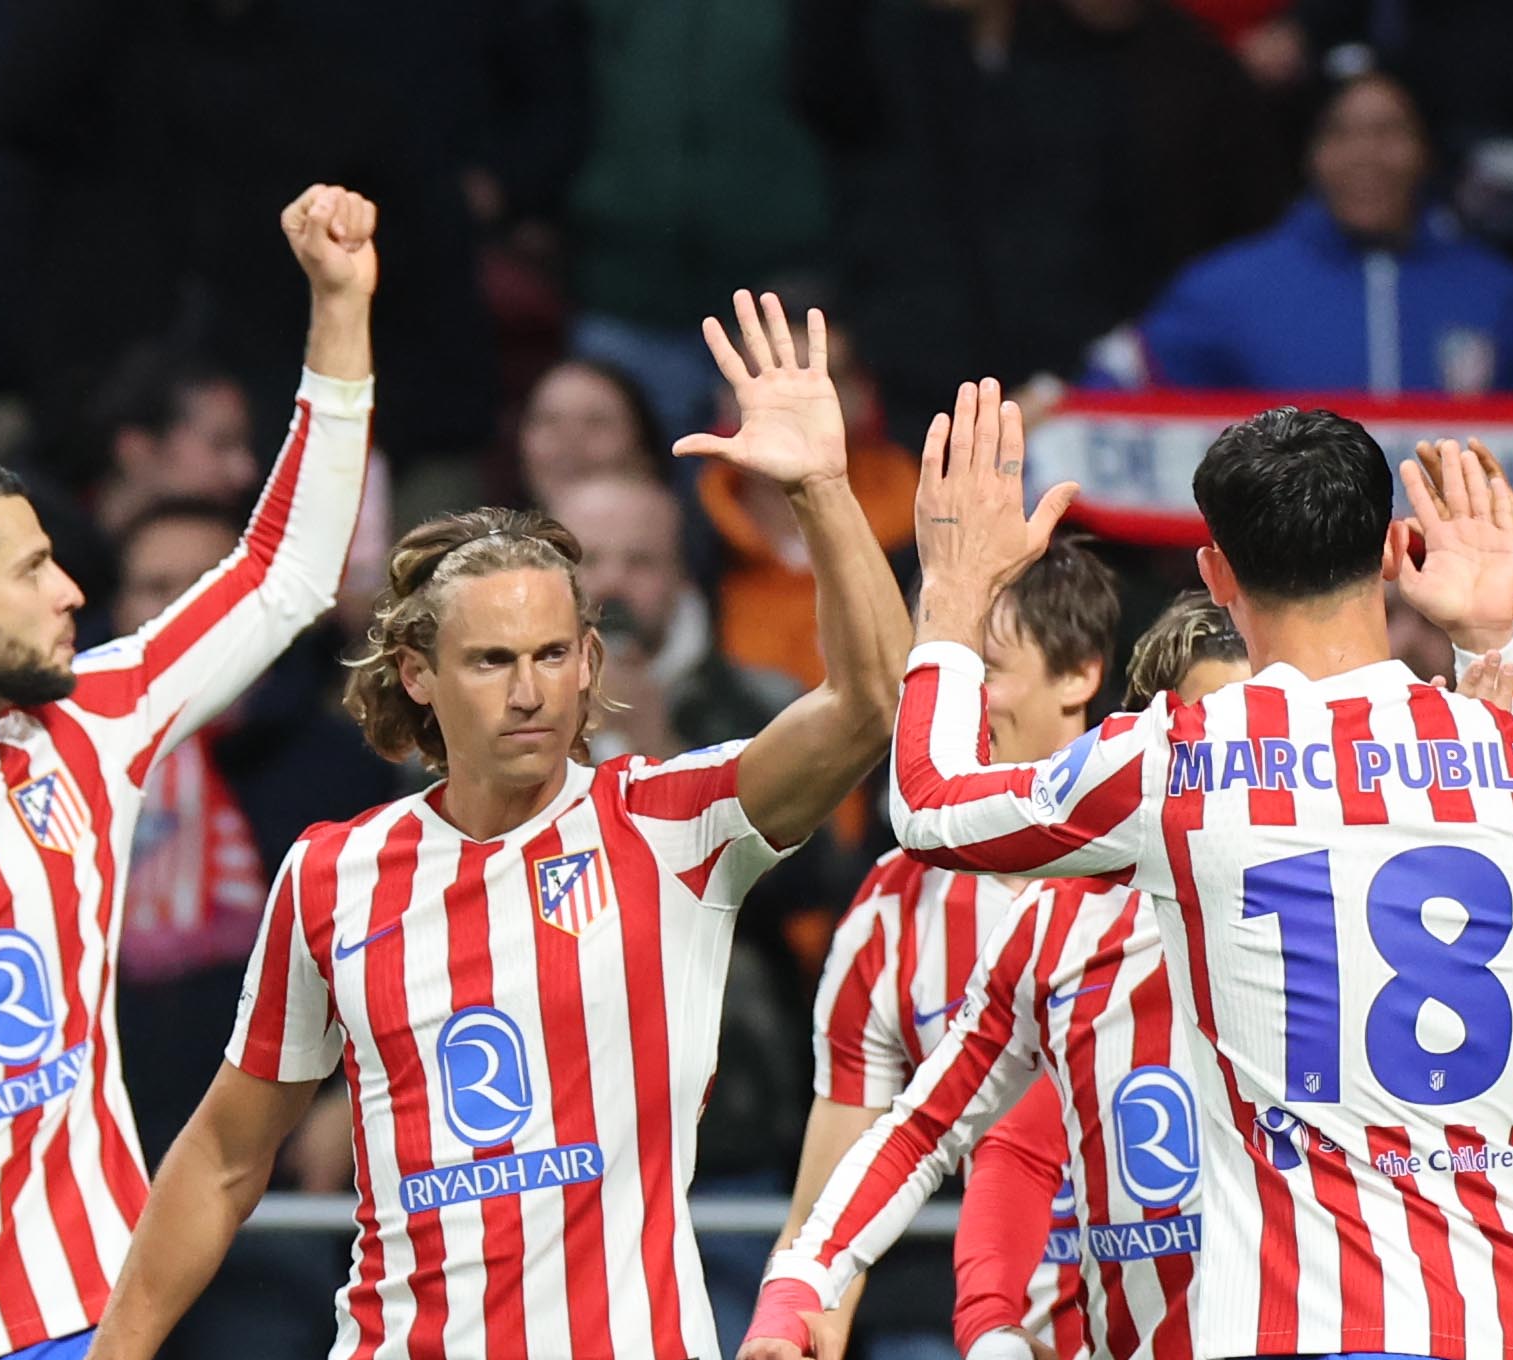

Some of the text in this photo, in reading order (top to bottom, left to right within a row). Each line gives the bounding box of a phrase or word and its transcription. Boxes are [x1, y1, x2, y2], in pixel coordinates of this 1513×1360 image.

[1168, 738, 1333, 796] MARC
[1242, 845, 1513, 1106] 18
[405, 1148, 598, 1209] RIYADH AIR
[1376, 1150, 1421, 1177] the
[1091, 1219, 1198, 1257] RIYADH
